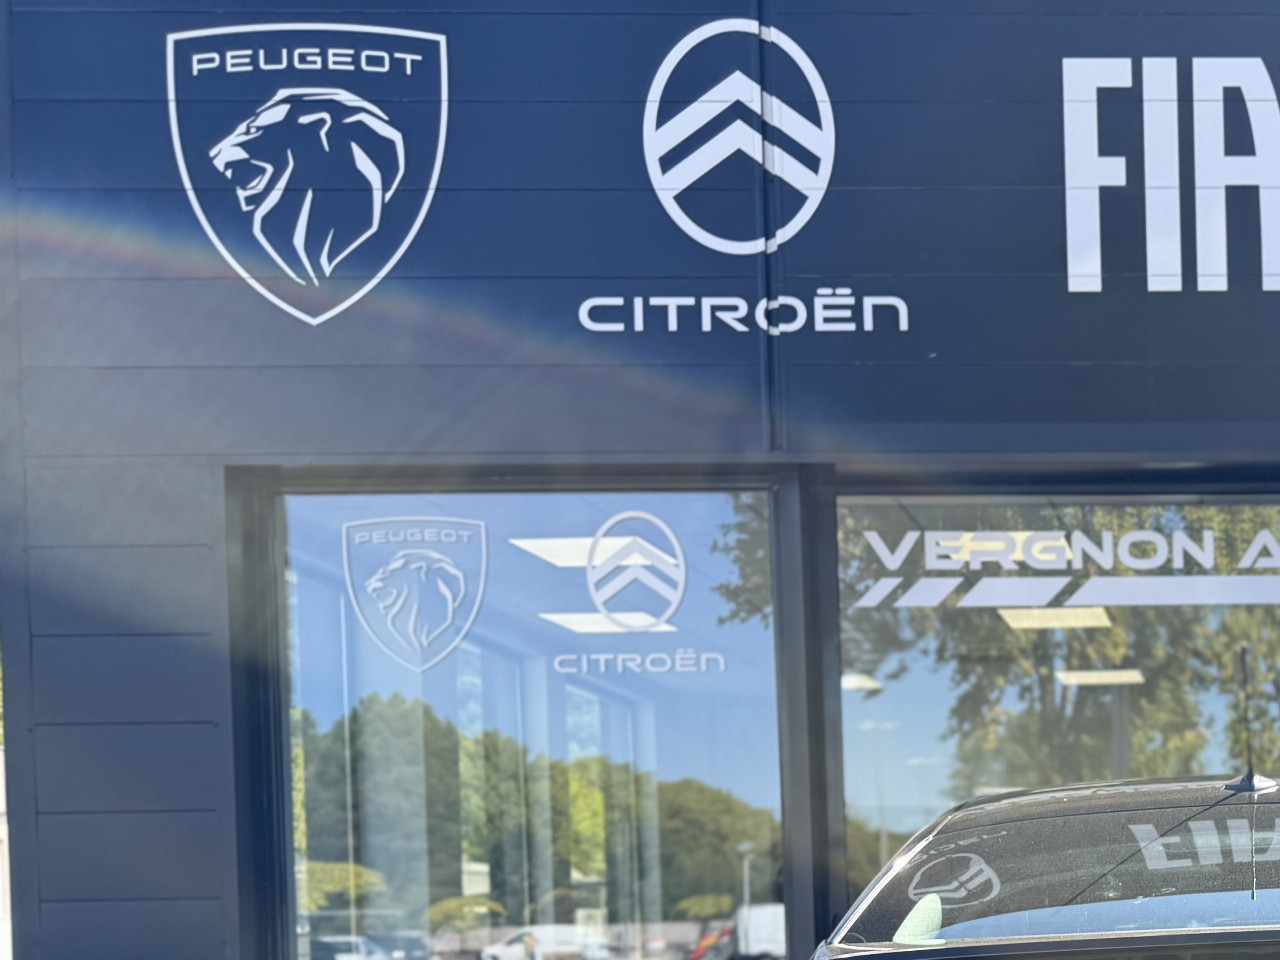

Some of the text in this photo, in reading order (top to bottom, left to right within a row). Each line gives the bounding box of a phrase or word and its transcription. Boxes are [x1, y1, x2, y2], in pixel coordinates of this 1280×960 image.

[192, 47, 423, 76] PEUGEOT
[354, 529, 474, 546] PEUGEOT
[863, 528, 1216, 572] VERGNON
